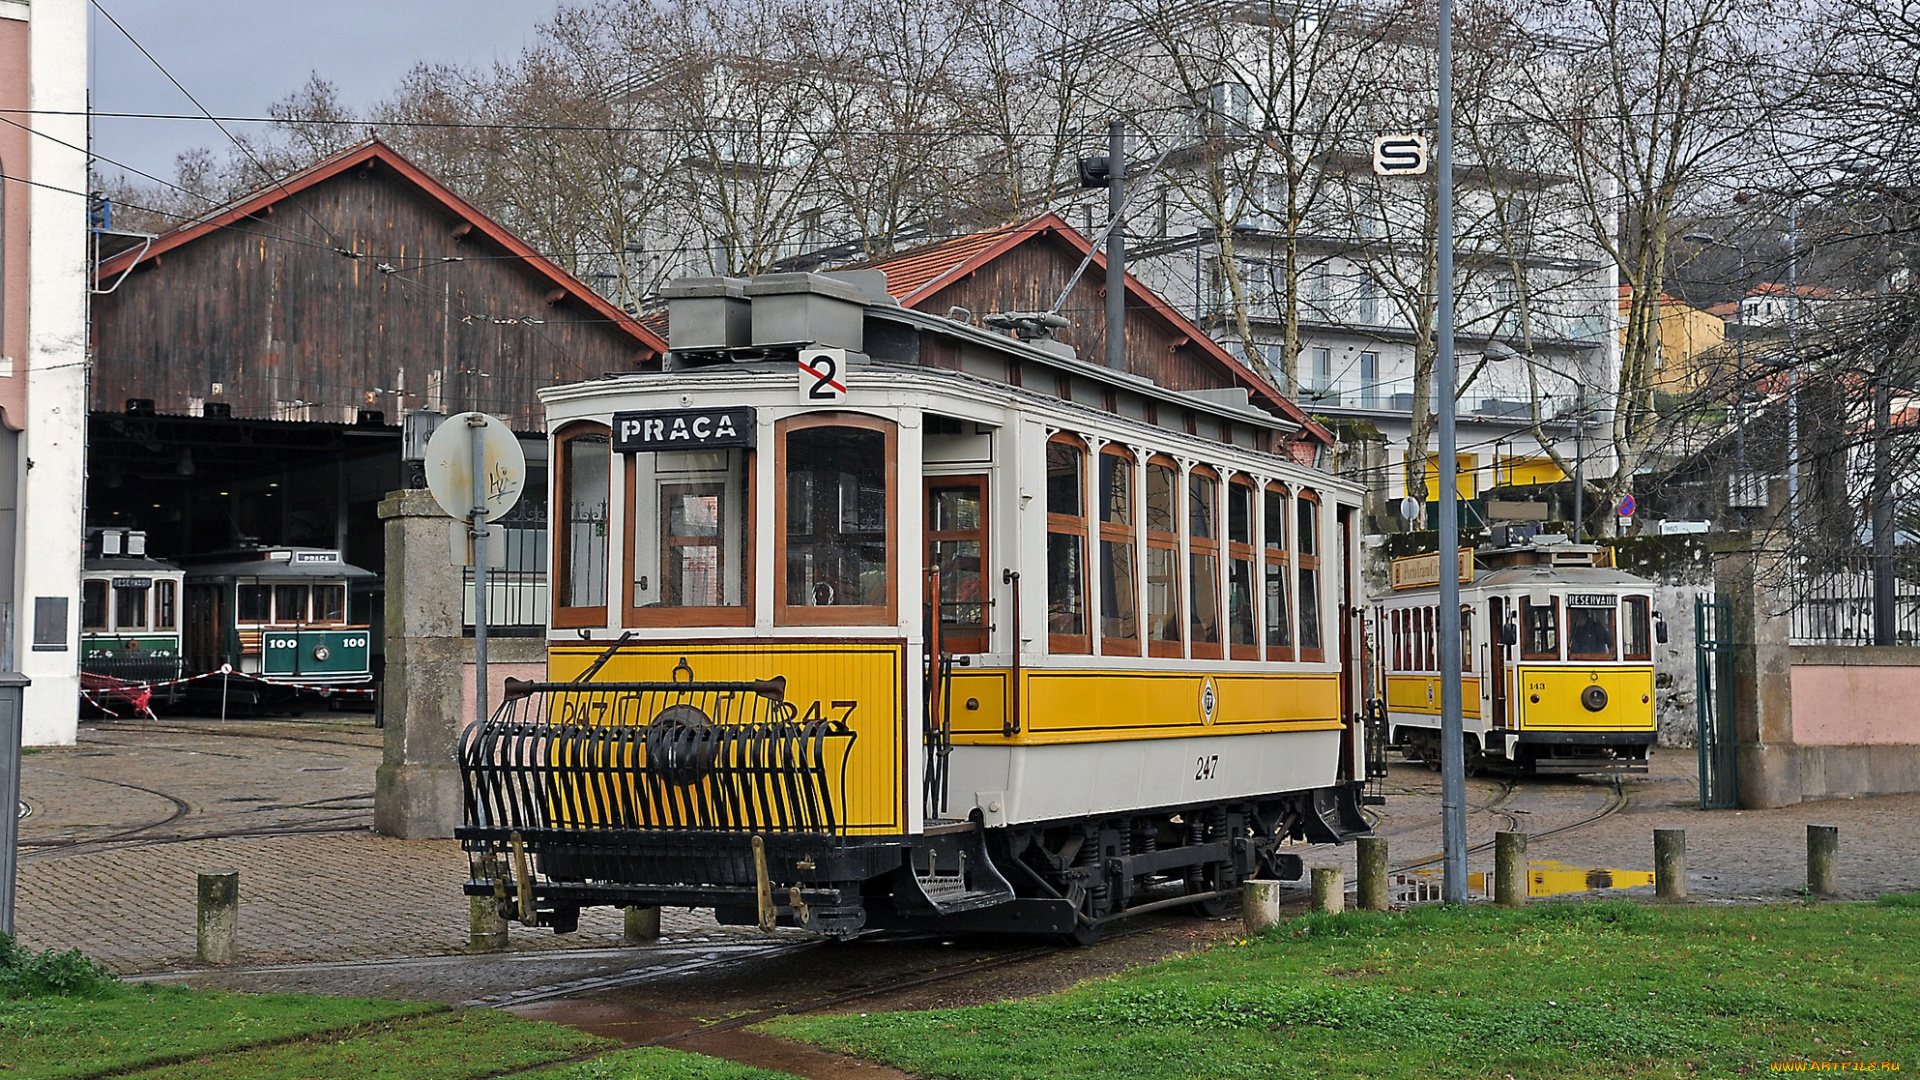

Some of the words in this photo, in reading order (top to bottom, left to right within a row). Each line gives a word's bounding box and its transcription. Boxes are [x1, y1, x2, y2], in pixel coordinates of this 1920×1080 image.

[808, 355, 837, 399] 2
[621, 415, 737, 442] PRAÇA
[269, 639, 297, 649] 100
[343, 638, 366, 648] 100
[776, 700, 858, 732] 247
[1195, 755, 1219, 781] 247
